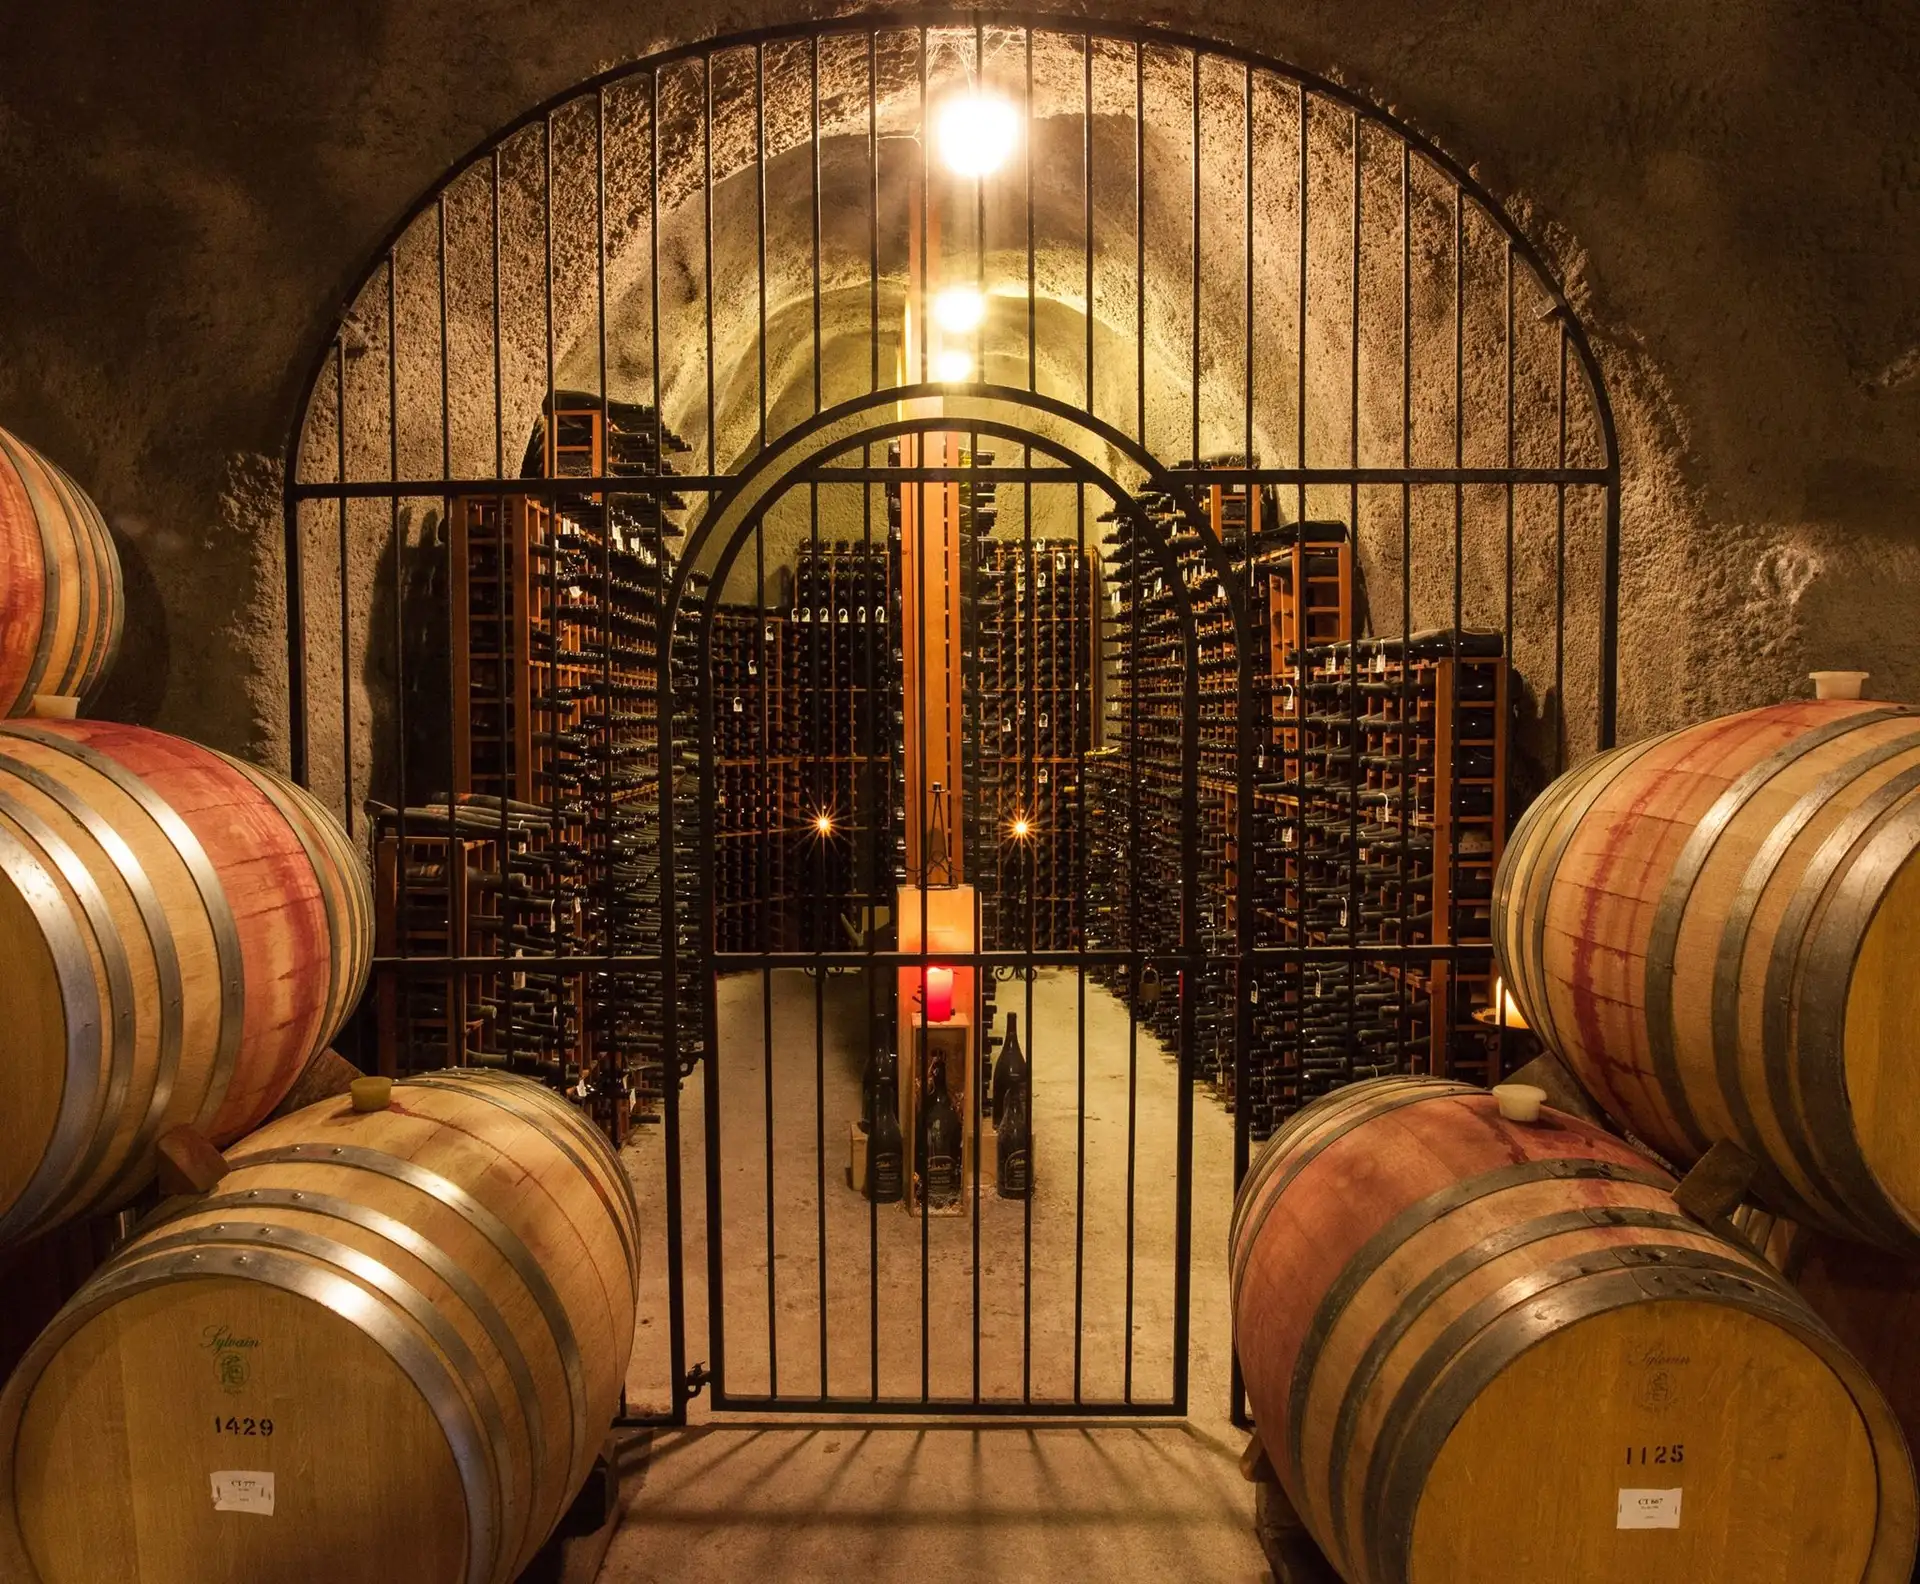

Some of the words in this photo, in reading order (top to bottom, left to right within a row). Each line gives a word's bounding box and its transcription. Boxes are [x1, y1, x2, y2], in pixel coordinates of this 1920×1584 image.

[200, 1325, 260, 1355] Sylvain
[215, 1416, 274, 1437] 1429
[1626, 1445, 1684, 1465] 1125
